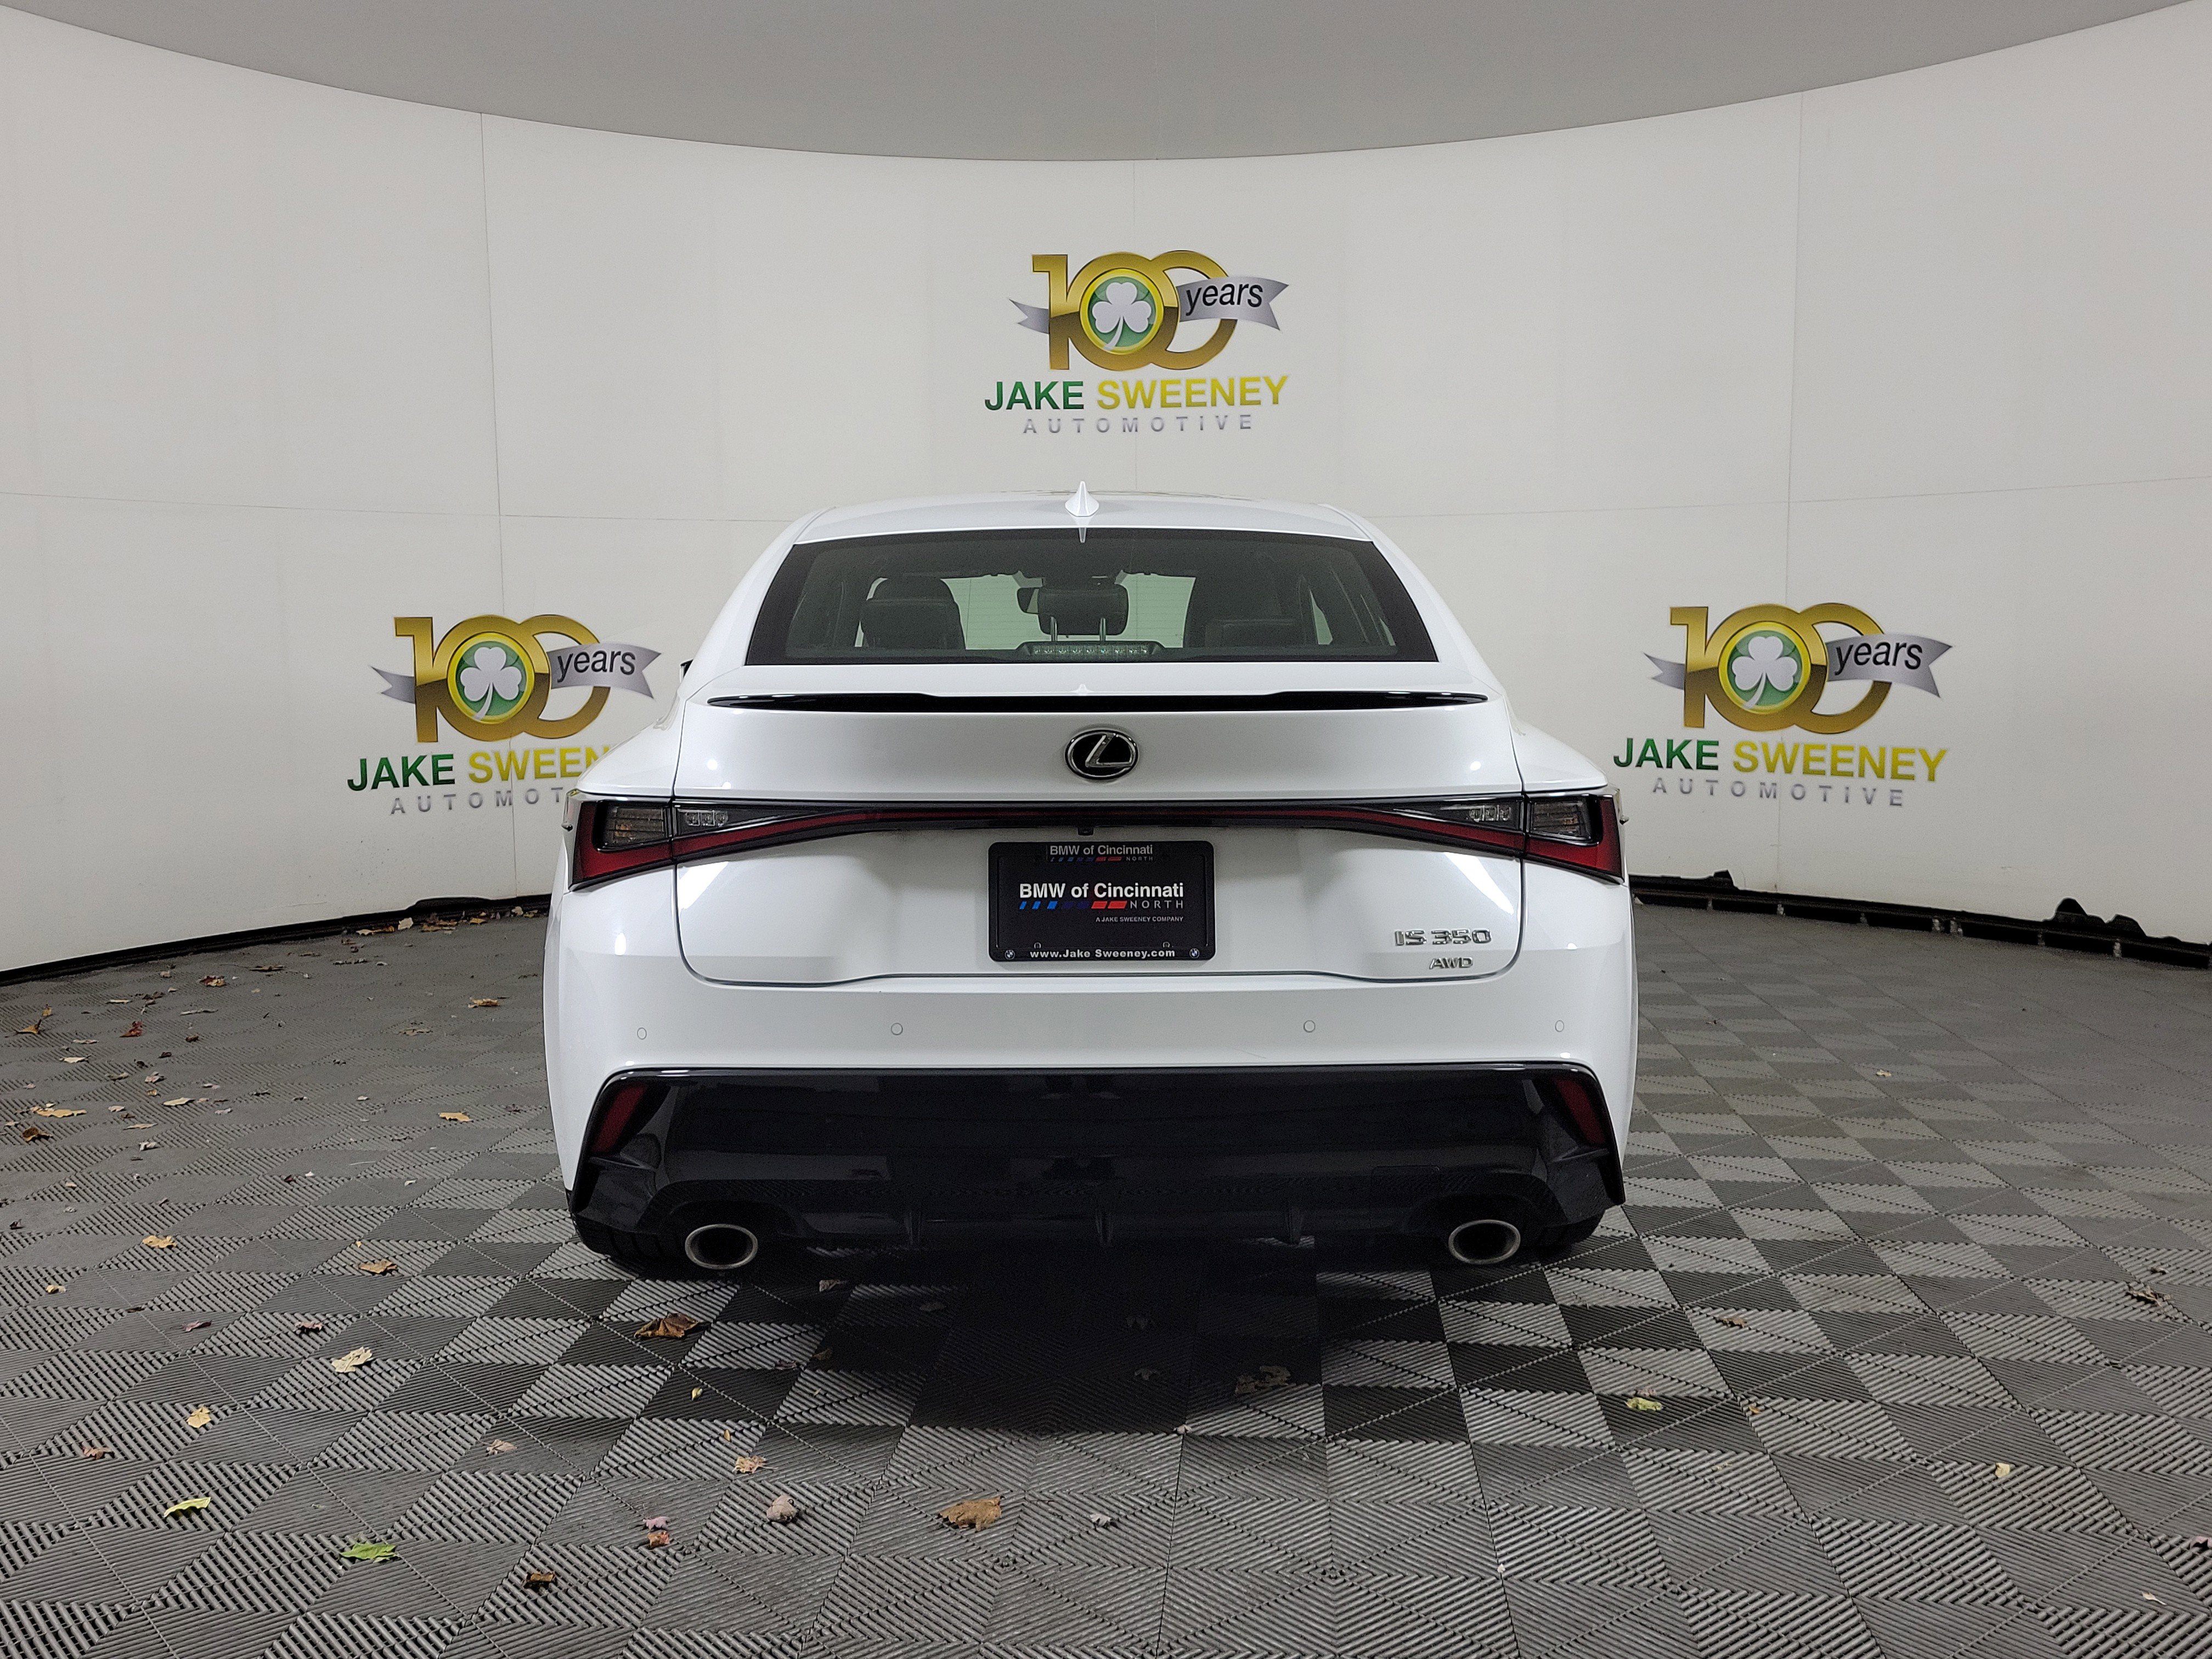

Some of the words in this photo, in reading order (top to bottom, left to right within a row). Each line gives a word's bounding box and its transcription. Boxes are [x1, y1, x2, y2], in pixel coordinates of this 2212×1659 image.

[1186, 281, 1263, 316] years
[984, 380, 1085, 411] JAKE
[1097, 375, 1289, 410] SWEENEY
[1023, 414, 1252, 435] AUTOMOTIVE
[556, 648, 636, 684] years
[1833, 641, 1923, 676] years
[347, 753, 456, 792] JAKE
[468, 744, 610, 783] SWEEN
[1612, 738, 1719, 771] JAKE
[1733, 741, 1948, 782] SWEENEY
[390, 786, 563, 815] AUTOMOT
[1652, 777, 1904, 807] AUTOMOTIVE
[1049, 845, 1080, 855] BMW
[1083, 845, 1094, 855] of
[1097, 844, 1153, 855] Cincinnati
[1019, 883, 1065, 898] BMW
[1071, 883, 1090, 898] of
[1094, 882, 1184, 898] Cincinnati
[1130, 900, 1184, 909] NORTH
[1395, 929, 1426, 946] IS
[1430, 928, 1492, 945] 350
[1030, 949, 1091, 958] www.Jake
[1094, 949, 1176, 959] Sweeney.com
[1429, 956, 1474, 970] AWD
